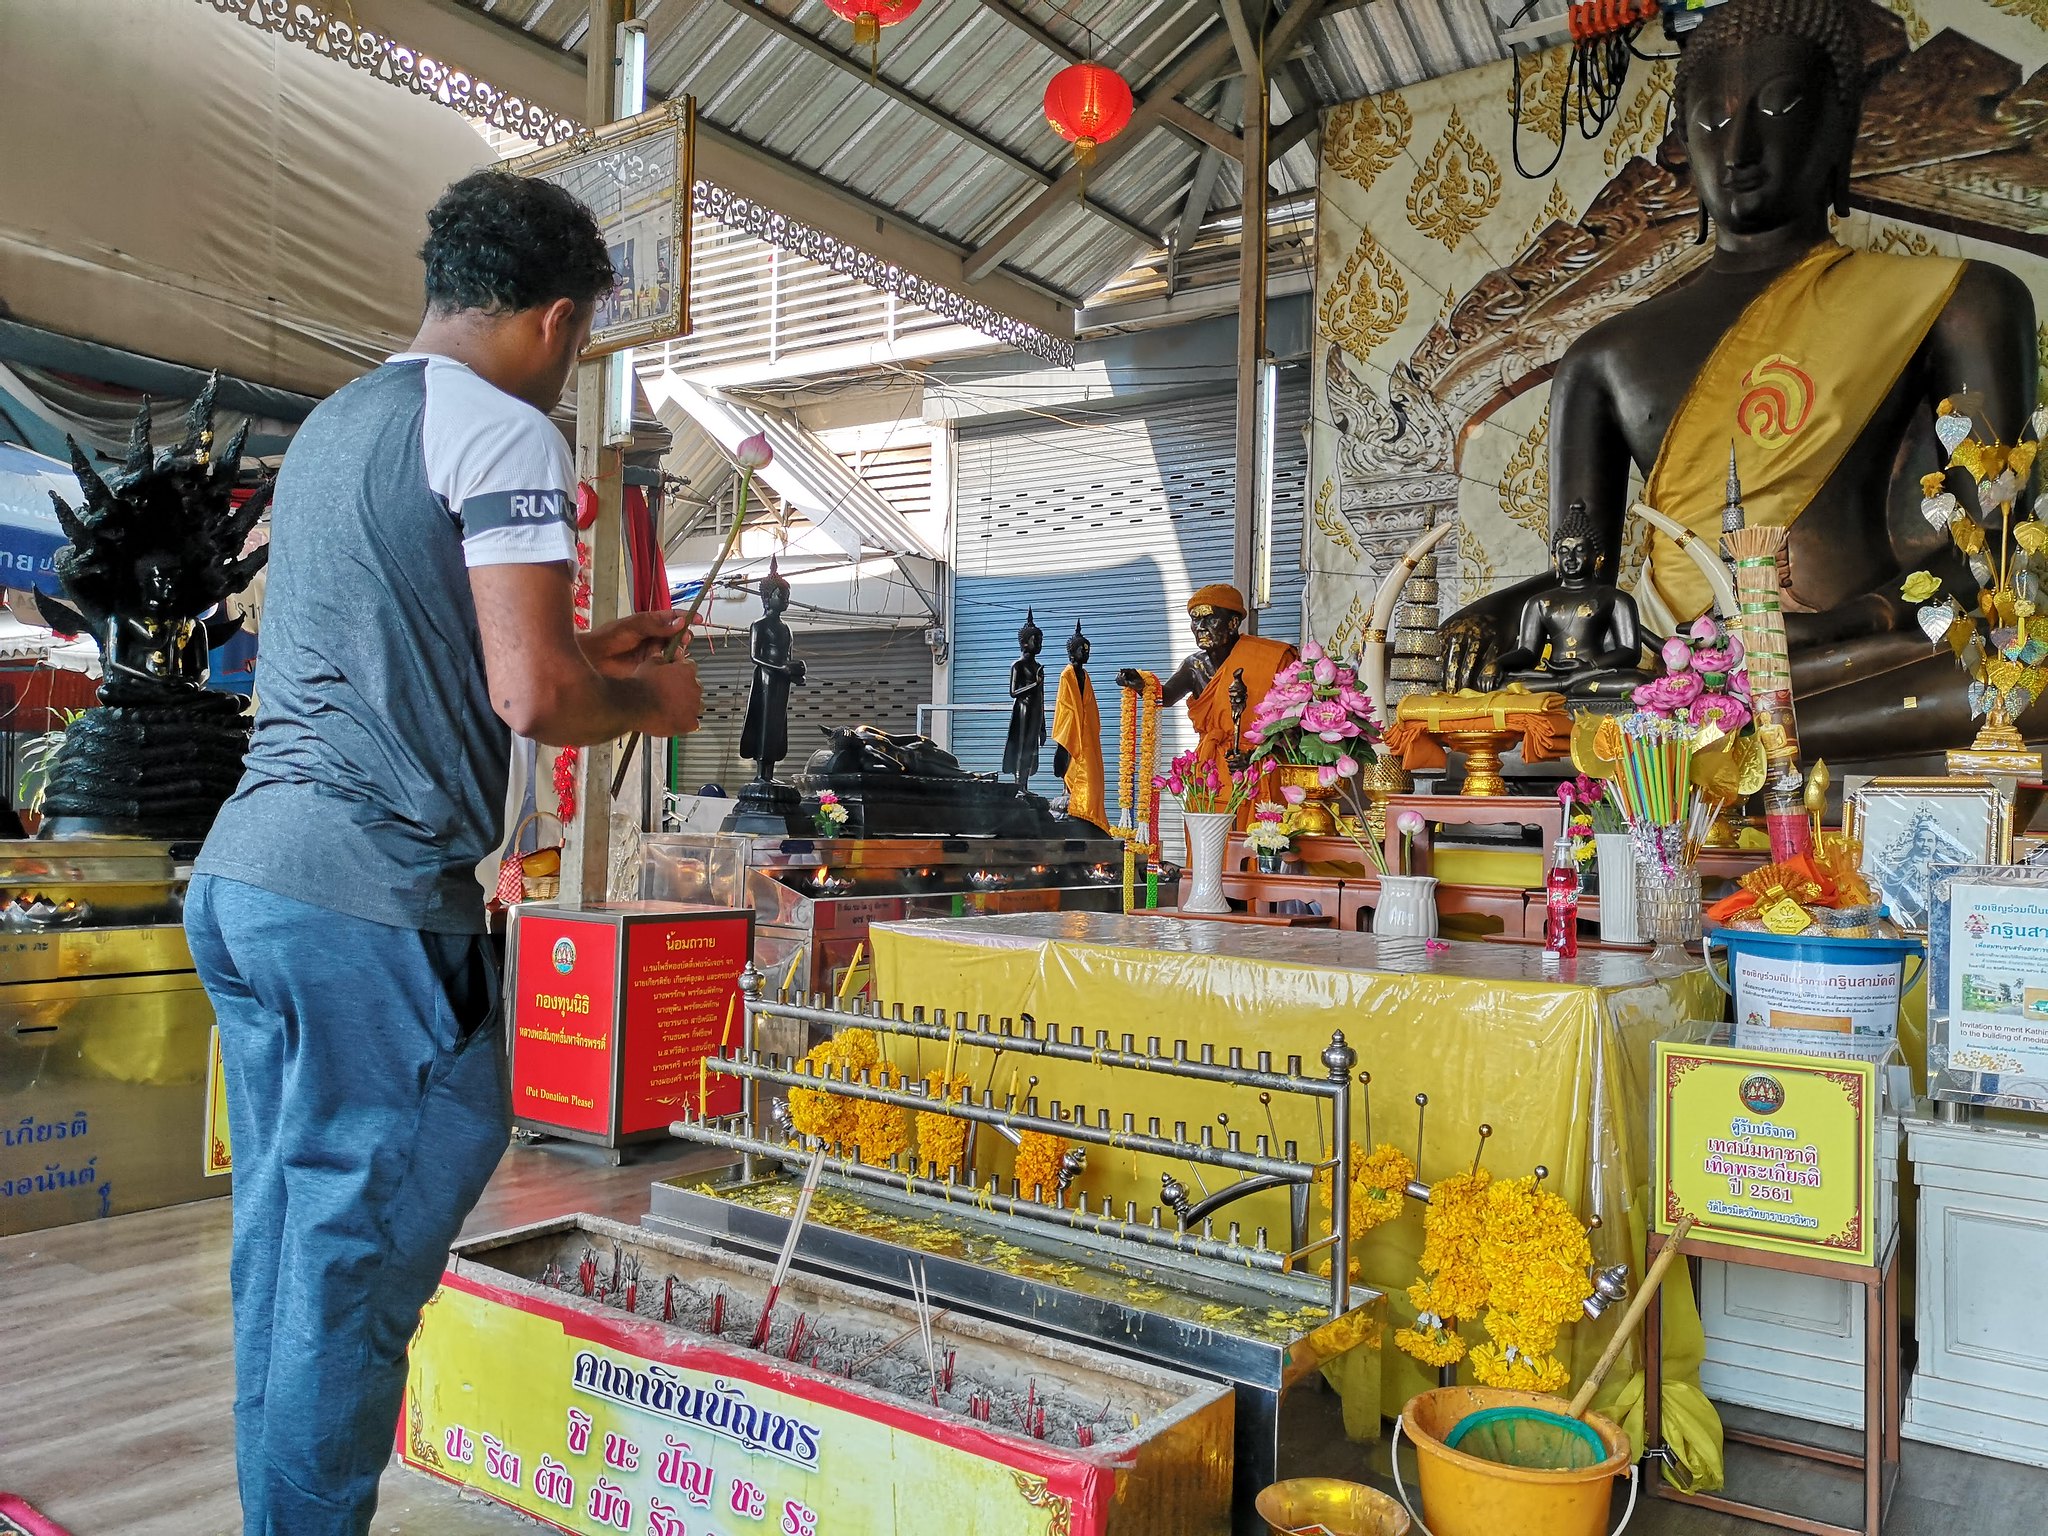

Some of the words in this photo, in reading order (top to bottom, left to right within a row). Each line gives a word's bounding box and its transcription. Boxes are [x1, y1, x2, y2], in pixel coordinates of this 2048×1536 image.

[1974, 903, 2048, 915] ขอเชิญร่วมเป็น
[665, 930, 716, 951] น้อมถวาย
[535, 993, 590, 1018] กองทุนนิธิ
[1960, 1021, 1993, 1031] Invitation
[1982, 1031, 2011, 1042] building
[525, 1085, 539, 1098] (Put
[540, 1088, 569, 1104] Donation
[571, 1094, 594, 1109] Please)
[0, 1111, 88, 1146] เกียรติ
[1708, 1137, 1817, 1164] เทศน์มหาชาติ
[1705, 1155, 1820, 1186] เทิดพระเกียรติ
[1729, 1178, 1742, 1195] ปี
[1750, 1184, 1792, 1202] 2561
[574, 1351, 821, 1462] คาถาชินบัญชร
[445, 1427, 473, 1462] ปะ
[483, 1432, 520, 1486] ริต
[536, 1454, 574, 1506] ตัง
[589, 1478, 631, 1531] มัง
[569, 1409, 590, 1453] ชิ
[605, 1434, 639, 1470] นะ
[658, 1435, 714, 1506] ปัญ
[732, 1479, 765, 1516] ชะ
[783, 1501, 816, 1536] ระ
